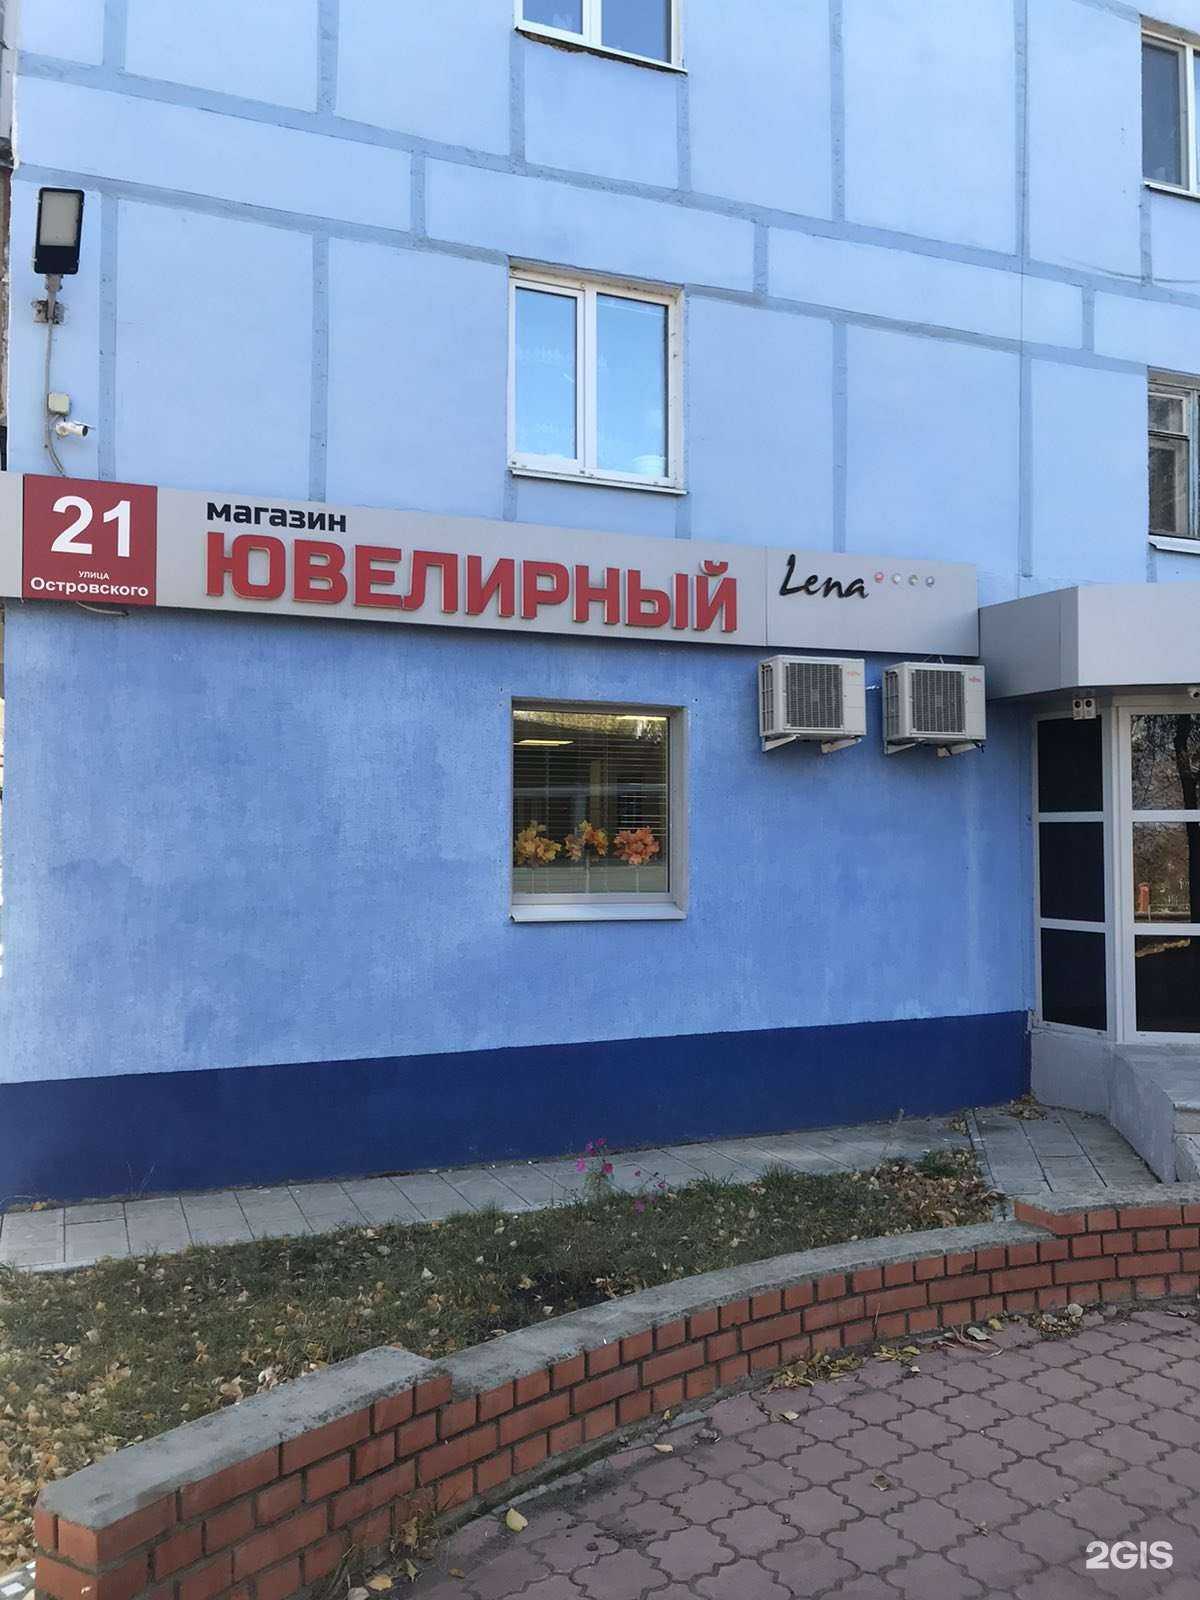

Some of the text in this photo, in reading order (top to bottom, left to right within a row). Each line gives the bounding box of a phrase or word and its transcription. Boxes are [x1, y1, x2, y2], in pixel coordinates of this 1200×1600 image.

[51, 495, 131, 558] 21
[207, 502, 347, 533] магазин
[30, 576, 149, 597] Островского
[78, 570, 110, 580] УЛИЦА
[206, 531, 738, 633] ЮВЕЛИРНЫЙ
[779, 553, 869, 599] Lena
